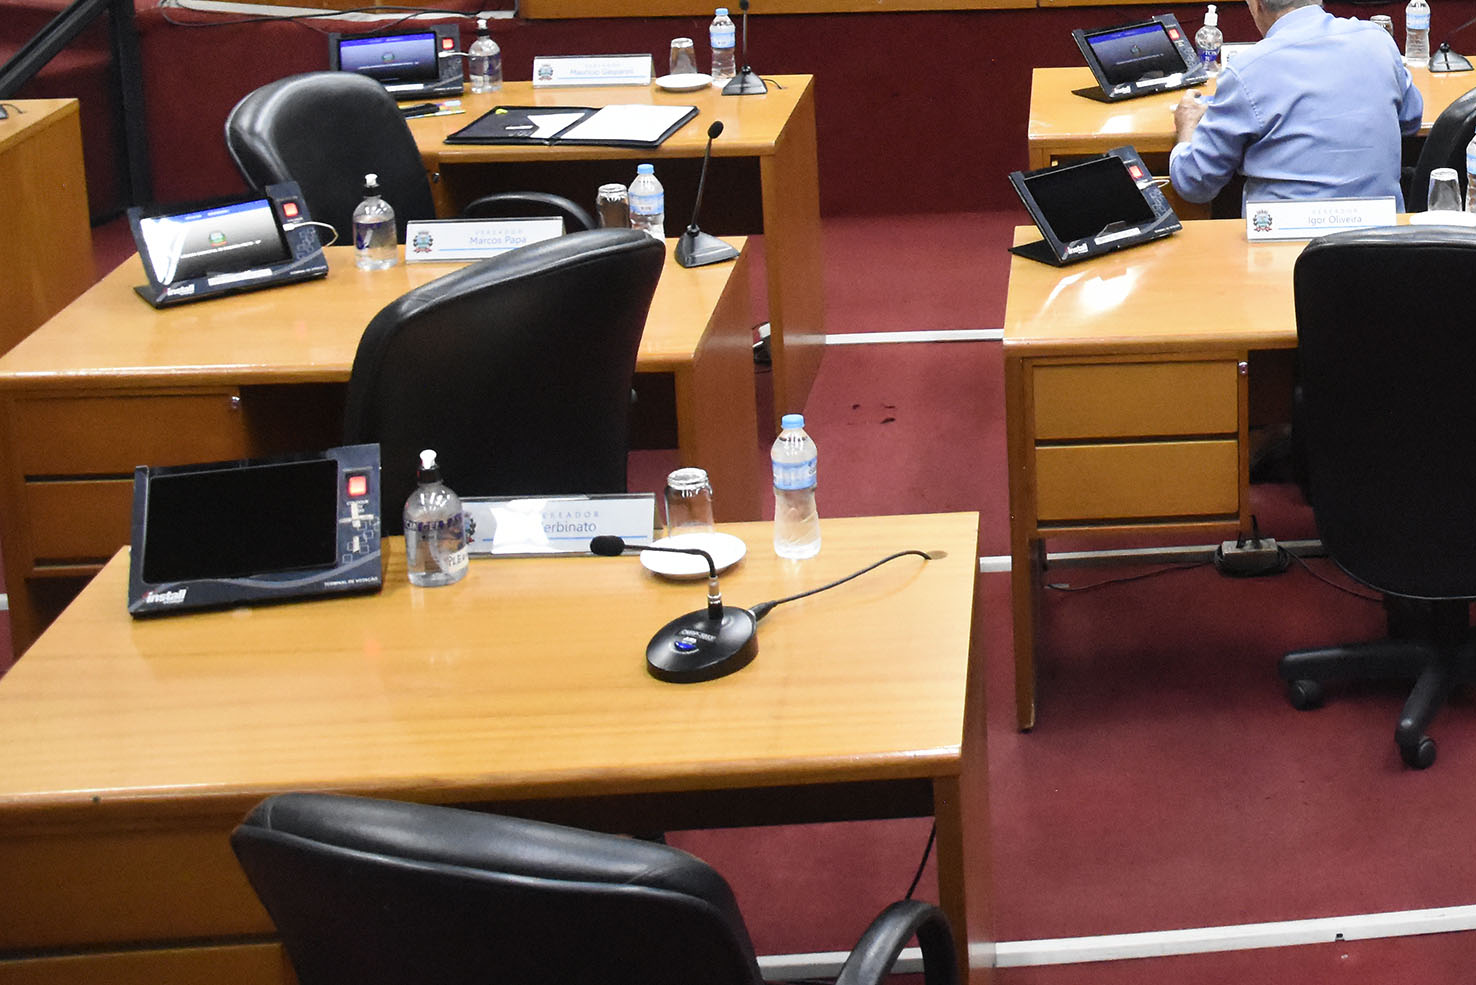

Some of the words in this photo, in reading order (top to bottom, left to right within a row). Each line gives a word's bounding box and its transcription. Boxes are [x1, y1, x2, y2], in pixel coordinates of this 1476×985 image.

[1308, 216, 1326, 224] Igor
[470, 237, 502, 245] Marcos
[505, 236, 526, 245] Papa
[543, 520, 596, 533] erbinato
[146, 589, 186, 604] install
